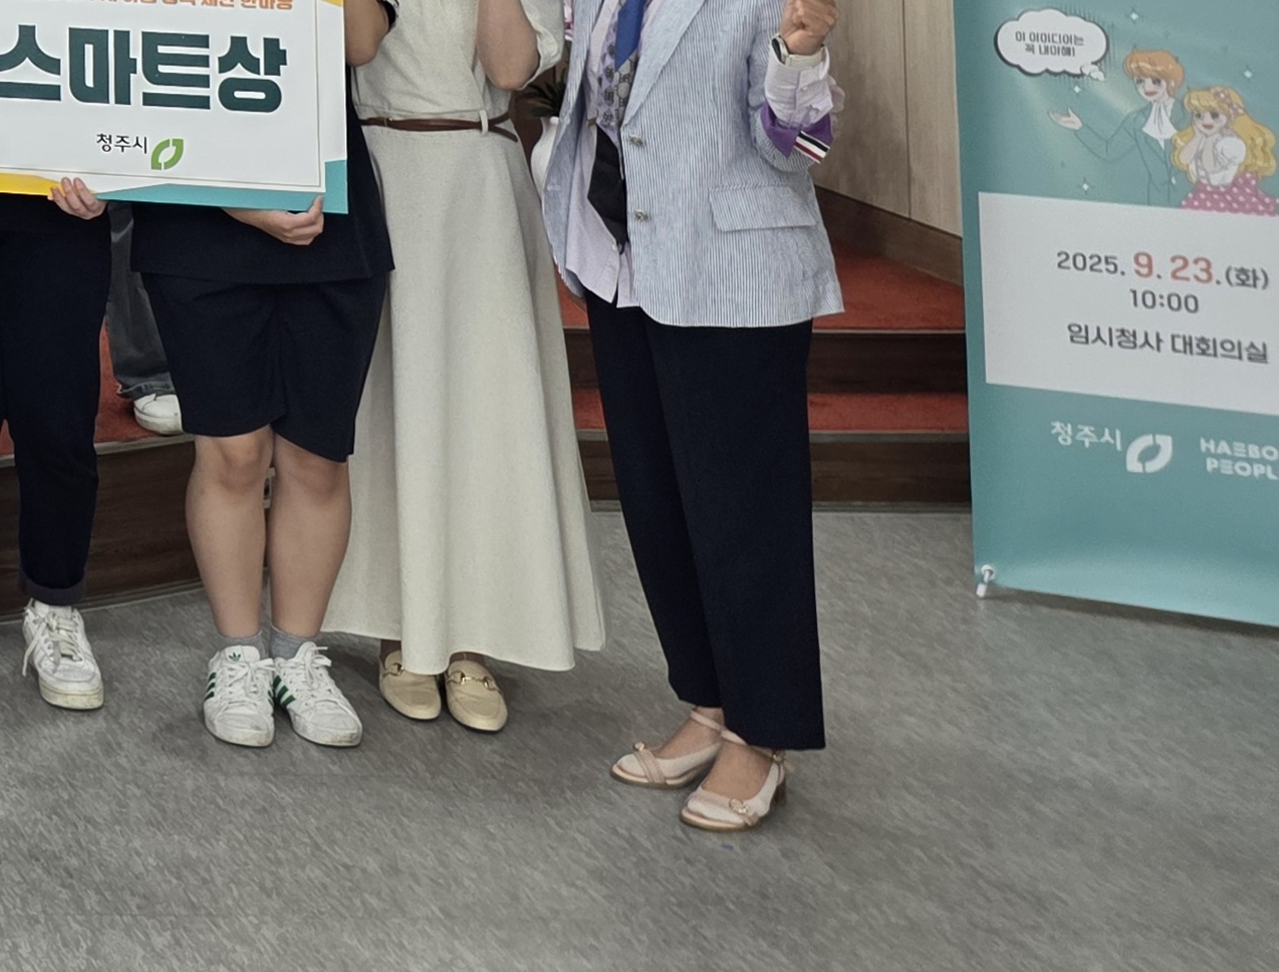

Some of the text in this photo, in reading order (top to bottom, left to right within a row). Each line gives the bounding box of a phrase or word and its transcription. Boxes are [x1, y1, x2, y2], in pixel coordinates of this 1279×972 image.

[96, 133, 148, 154] 청주시
[1056, 251, 1126, 276] 2025.
[1133, 251, 1162, 279] 9.
[1130, 288, 1199, 313] 10:00
[1067, 323, 1269, 364] 임시청사 대회의실
[1051, 421, 1122, 451] 청주시
